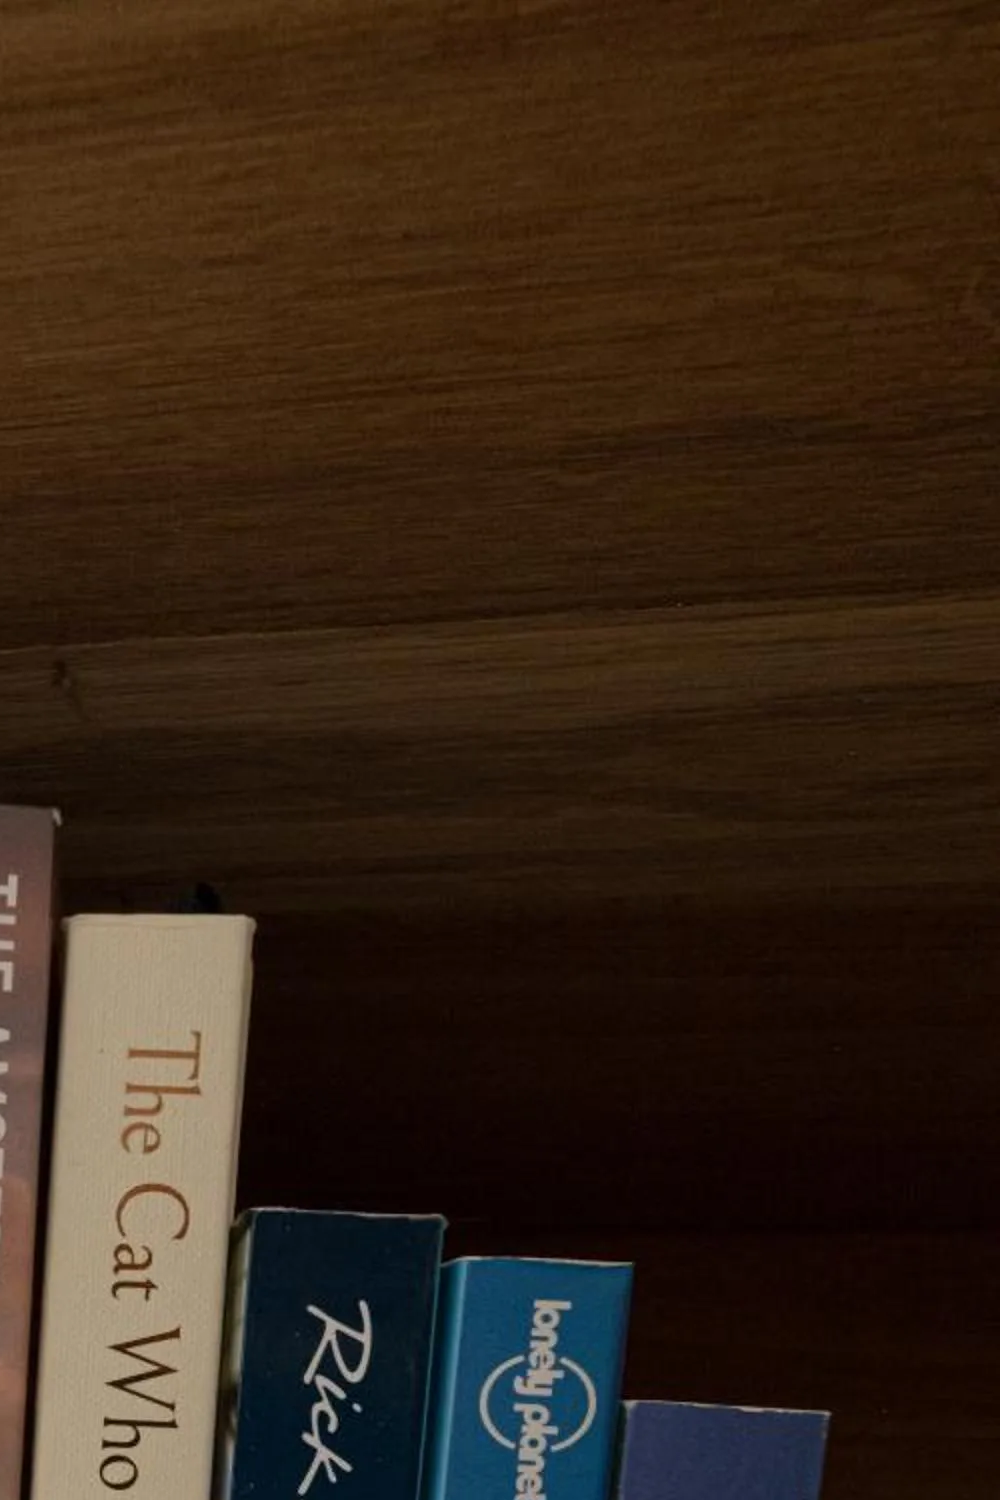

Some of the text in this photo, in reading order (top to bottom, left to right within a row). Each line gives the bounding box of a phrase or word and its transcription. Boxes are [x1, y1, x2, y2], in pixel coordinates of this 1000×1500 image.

[120, 1030, 202, 1155] The
[111, 1182, 191, 1303] Cat
[99, 1325, 182, 1492] Who
[298, 1300, 373, 1496] Rick
[512, 1299, 572, 1397] lonely
